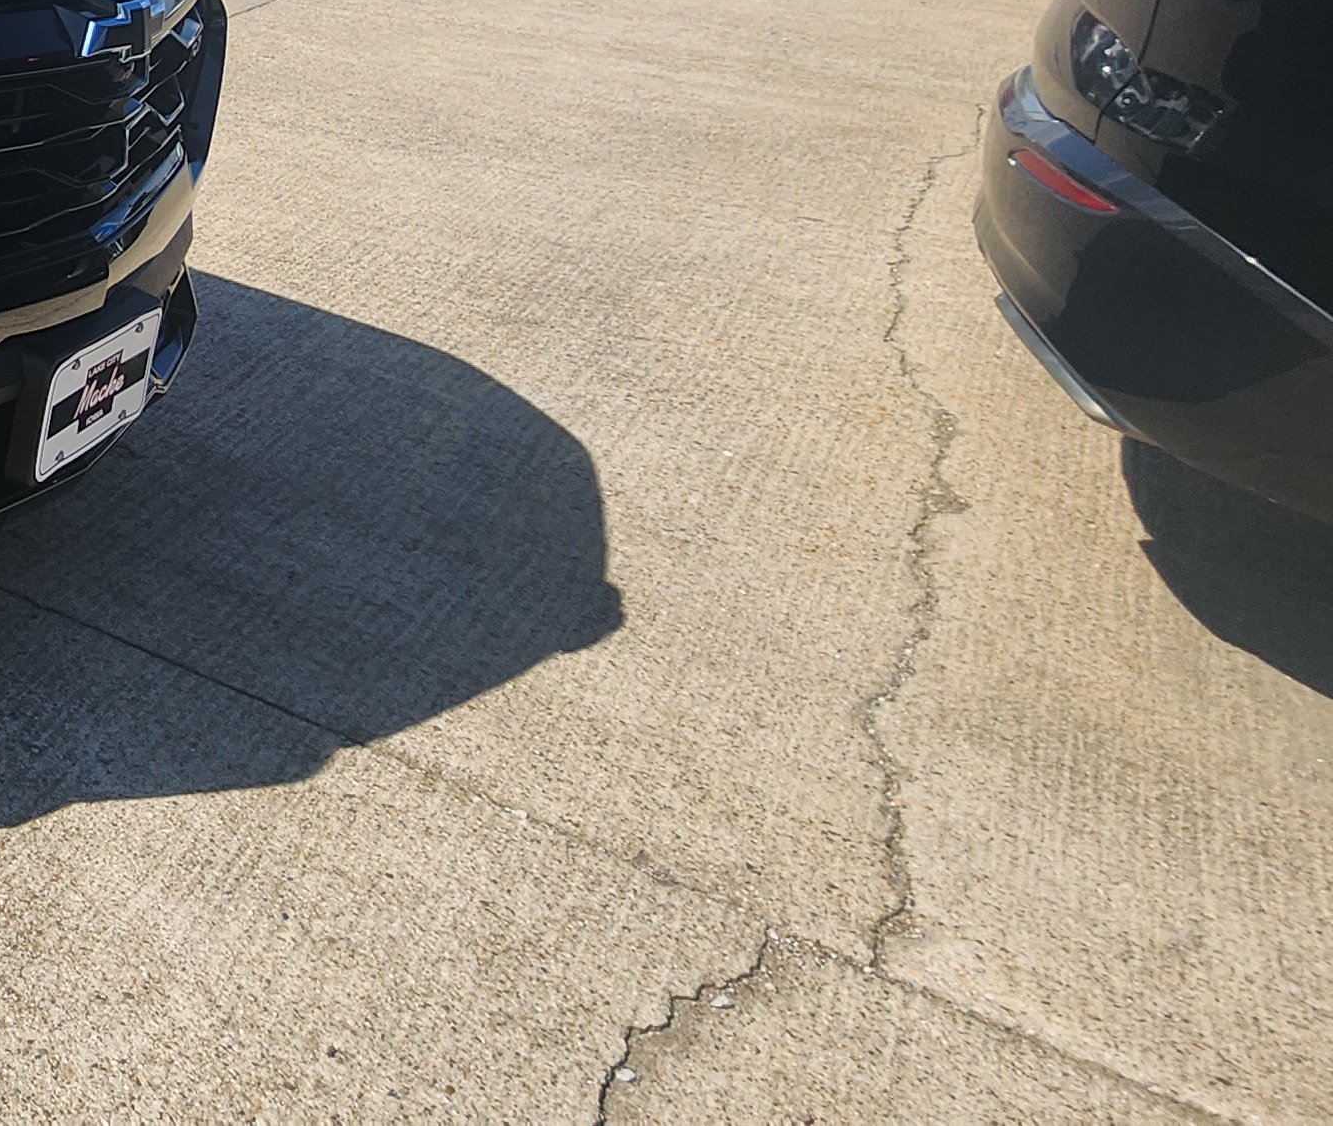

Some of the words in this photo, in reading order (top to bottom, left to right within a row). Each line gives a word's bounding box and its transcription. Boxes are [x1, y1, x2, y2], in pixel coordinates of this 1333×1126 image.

[88, 362, 106, 378] LAKE
[106, 353, 122, 367] CITY
[73, 365, 125, 420] Macke
